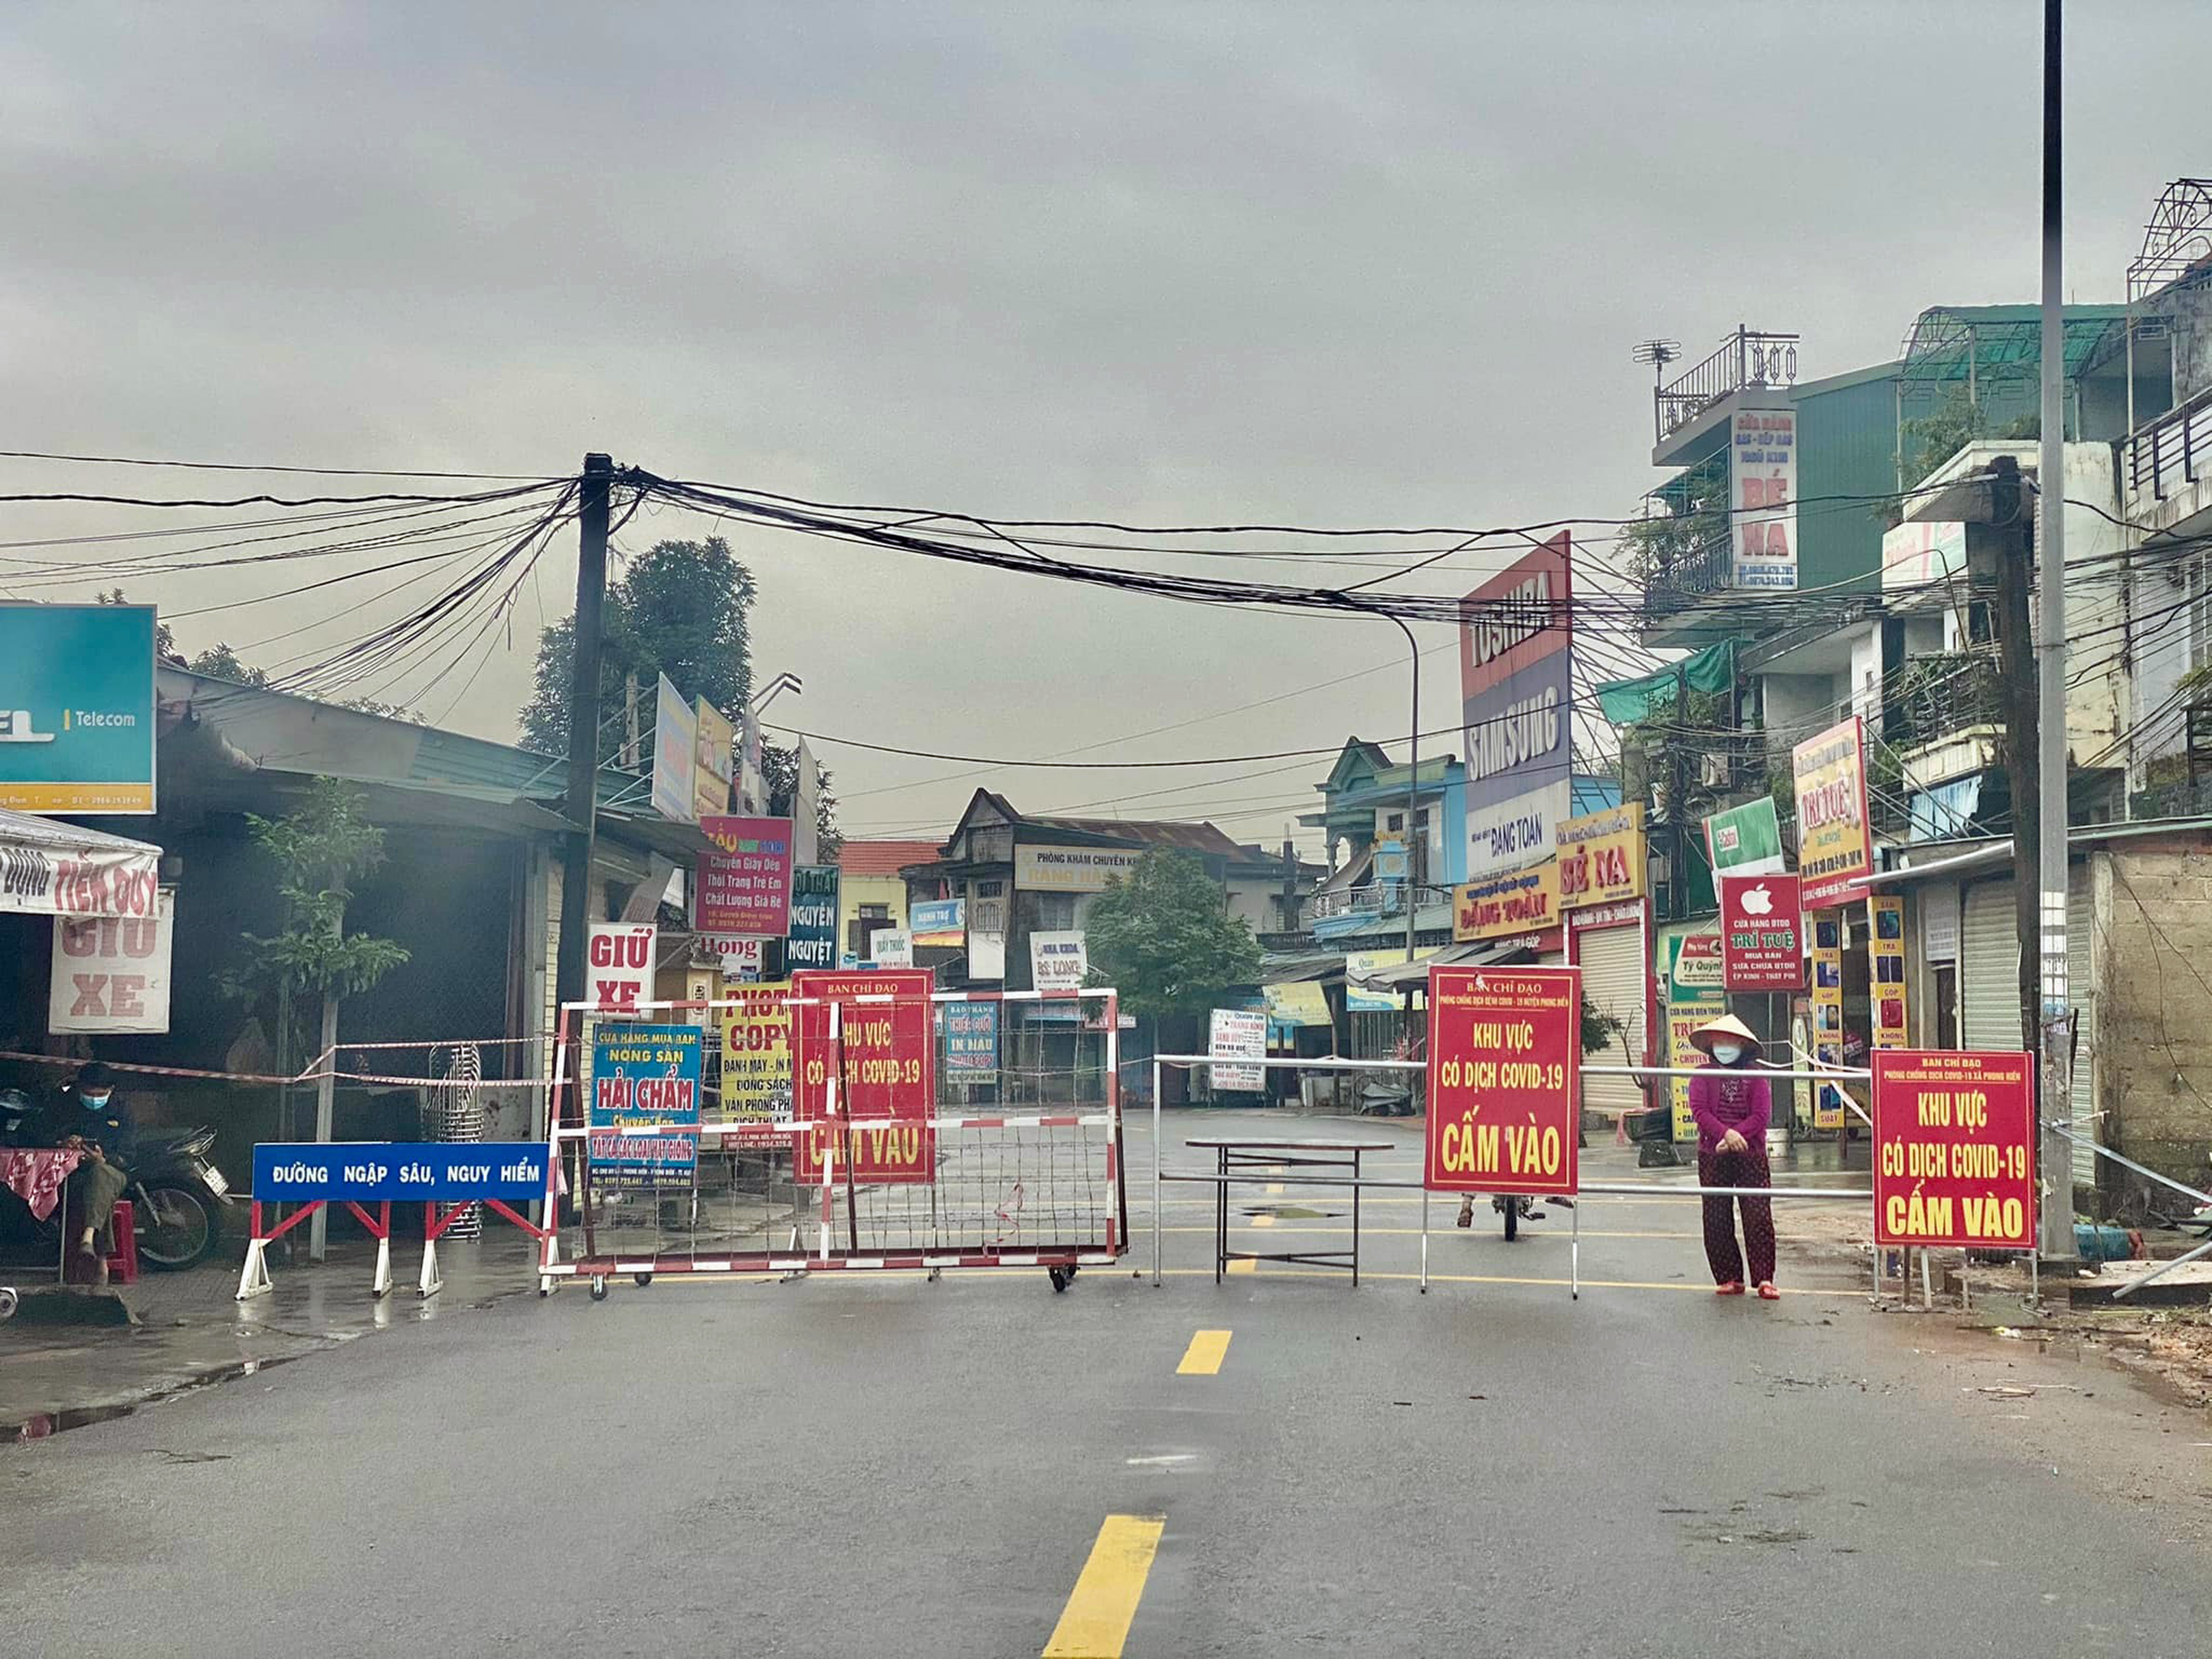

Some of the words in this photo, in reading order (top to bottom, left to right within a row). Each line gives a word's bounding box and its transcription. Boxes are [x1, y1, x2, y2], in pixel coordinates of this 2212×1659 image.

[1743, 468, 1787, 510] BÉ
[1743, 523, 1788, 556] NA
[1469, 571, 1551, 667] TOSHIBA
[76, 711, 135, 726] Telecom
[1469, 686, 1558, 781] SAMSUNG
[728, 874, 750, 889] Trang
[769, 877, 781, 889] Em
[1559, 845, 1589, 895] BÉ
[1594, 846, 1630, 888] NA
[591, 928, 653, 968] GIỮ
[1762, 930, 1794, 952] TUỆ
[70, 974, 145, 1016] XE
[595, 980, 640, 1014] XE
[726, 989, 792, 1018] PHOT
[828, 984, 850, 994] BAN
[1467, 982, 1490, 993] BAN
[1517, 983, 1542, 996] ĐẠO
[865, 1018, 891, 1051] VỰC
[1474, 1023, 1501, 1049] KHU
[1506, 1020, 1533, 1055] VỰC
[807, 1053, 824, 1085] CÓ
[863, 1059, 920, 1085] COVID-19
[1442, 1055, 1460, 1087] CÓ
[1465, 1061, 1496, 1093] DỊCH
[1501, 1063, 1563, 1089] COVID-19
[1922, 1058, 1942, 1068] BAN
[597, 1066, 633, 1109] HẢI
[1918, 1092, 1950, 1127] KHU
[1955, 1089, 1987, 1135] VỰC
[870, 1105, 919, 1165] VÀO
[1442, 1105, 1499, 1172] CẤM
[1508, 1112, 1561, 1176] VÀO
[273, 1162, 328, 1183] ĐƯỜNG
[344, 1162, 388, 1186] NGẬP
[399, 1163, 435, 1186] SÂU,
[447, 1165, 491, 1183] NGUY
[500, 1156, 540, 1182] HIỂM
[1882, 1135, 1905, 1177] CÓ
[1908, 1142, 1947, 1181] DỊCH
[1952, 1143, 2025, 1180] COVID-19
[1886, 1182, 1953, 1237] CẤM
[1962, 1191, 2023, 1239] VÀO
